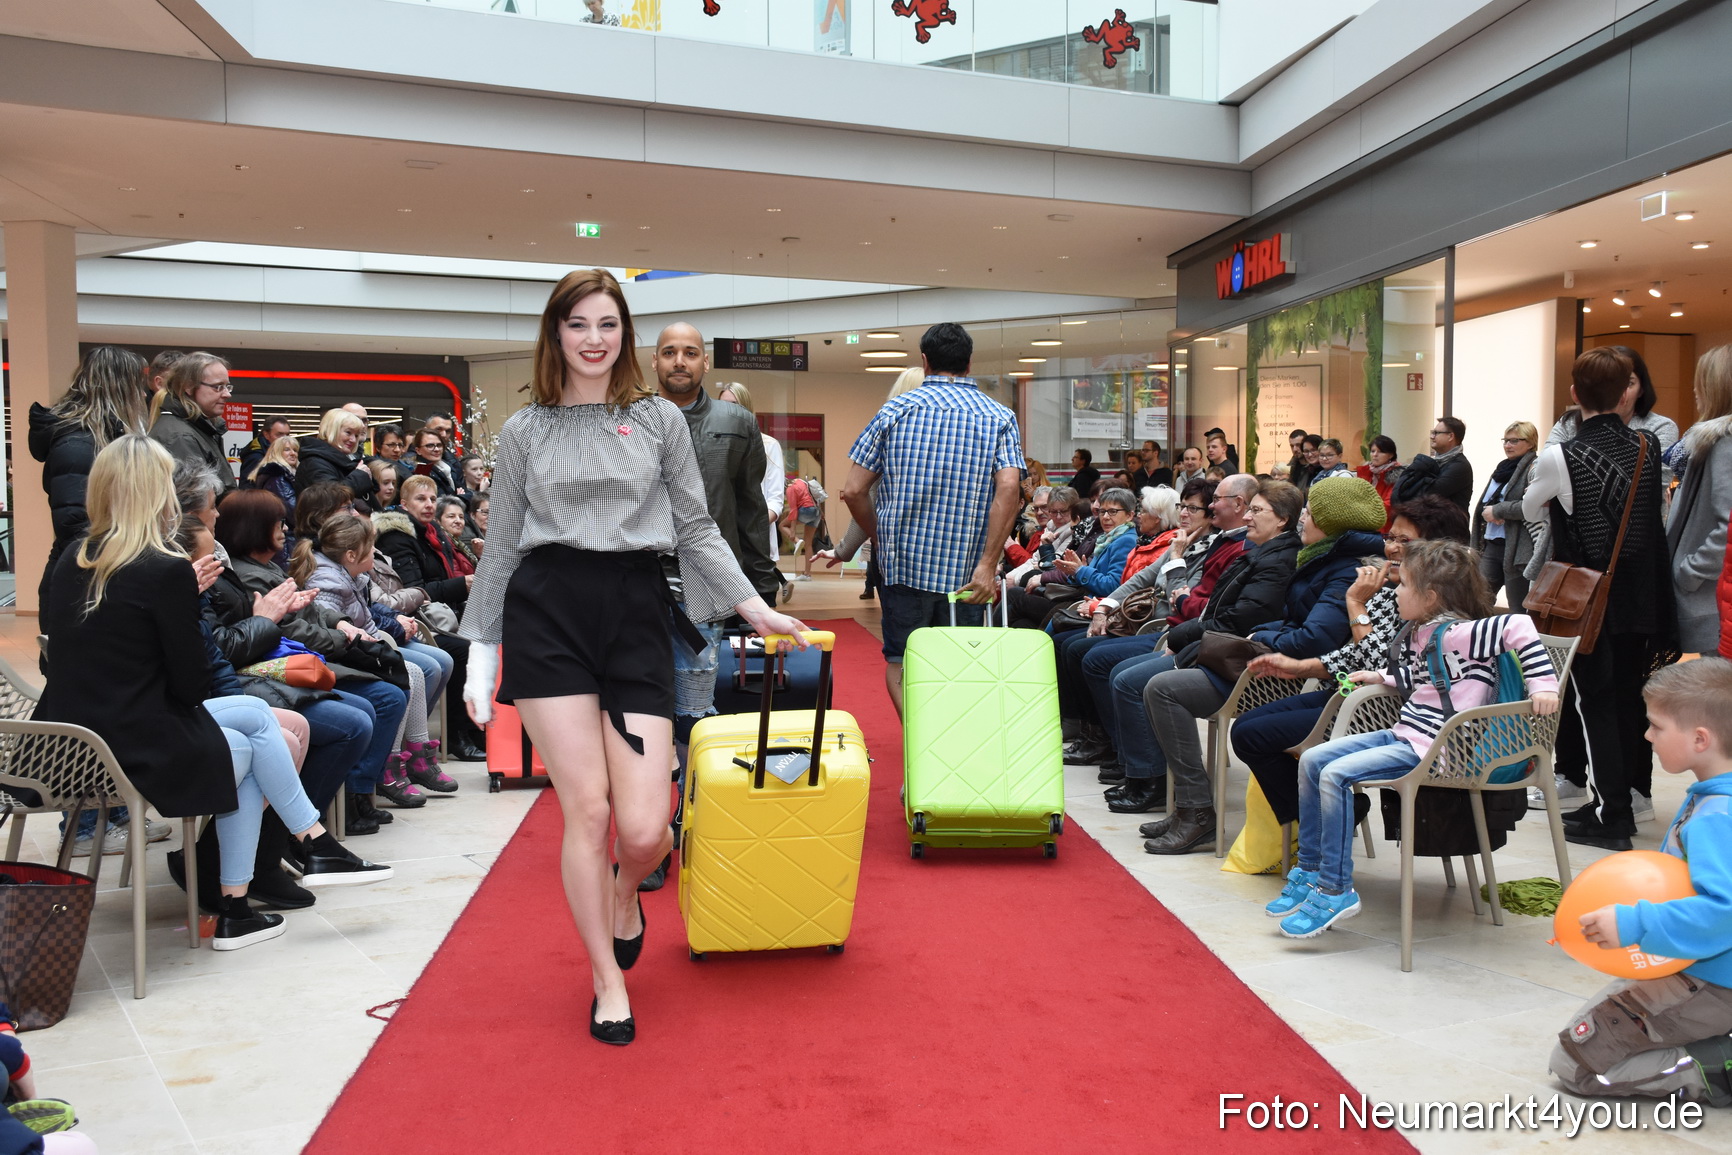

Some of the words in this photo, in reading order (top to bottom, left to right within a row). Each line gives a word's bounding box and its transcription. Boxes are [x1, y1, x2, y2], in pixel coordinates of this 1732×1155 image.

[1215, 232, 1286, 300] WÖHRL
[775, 751, 801, 773] TITAN
[1626, 946, 1648, 969] TER
